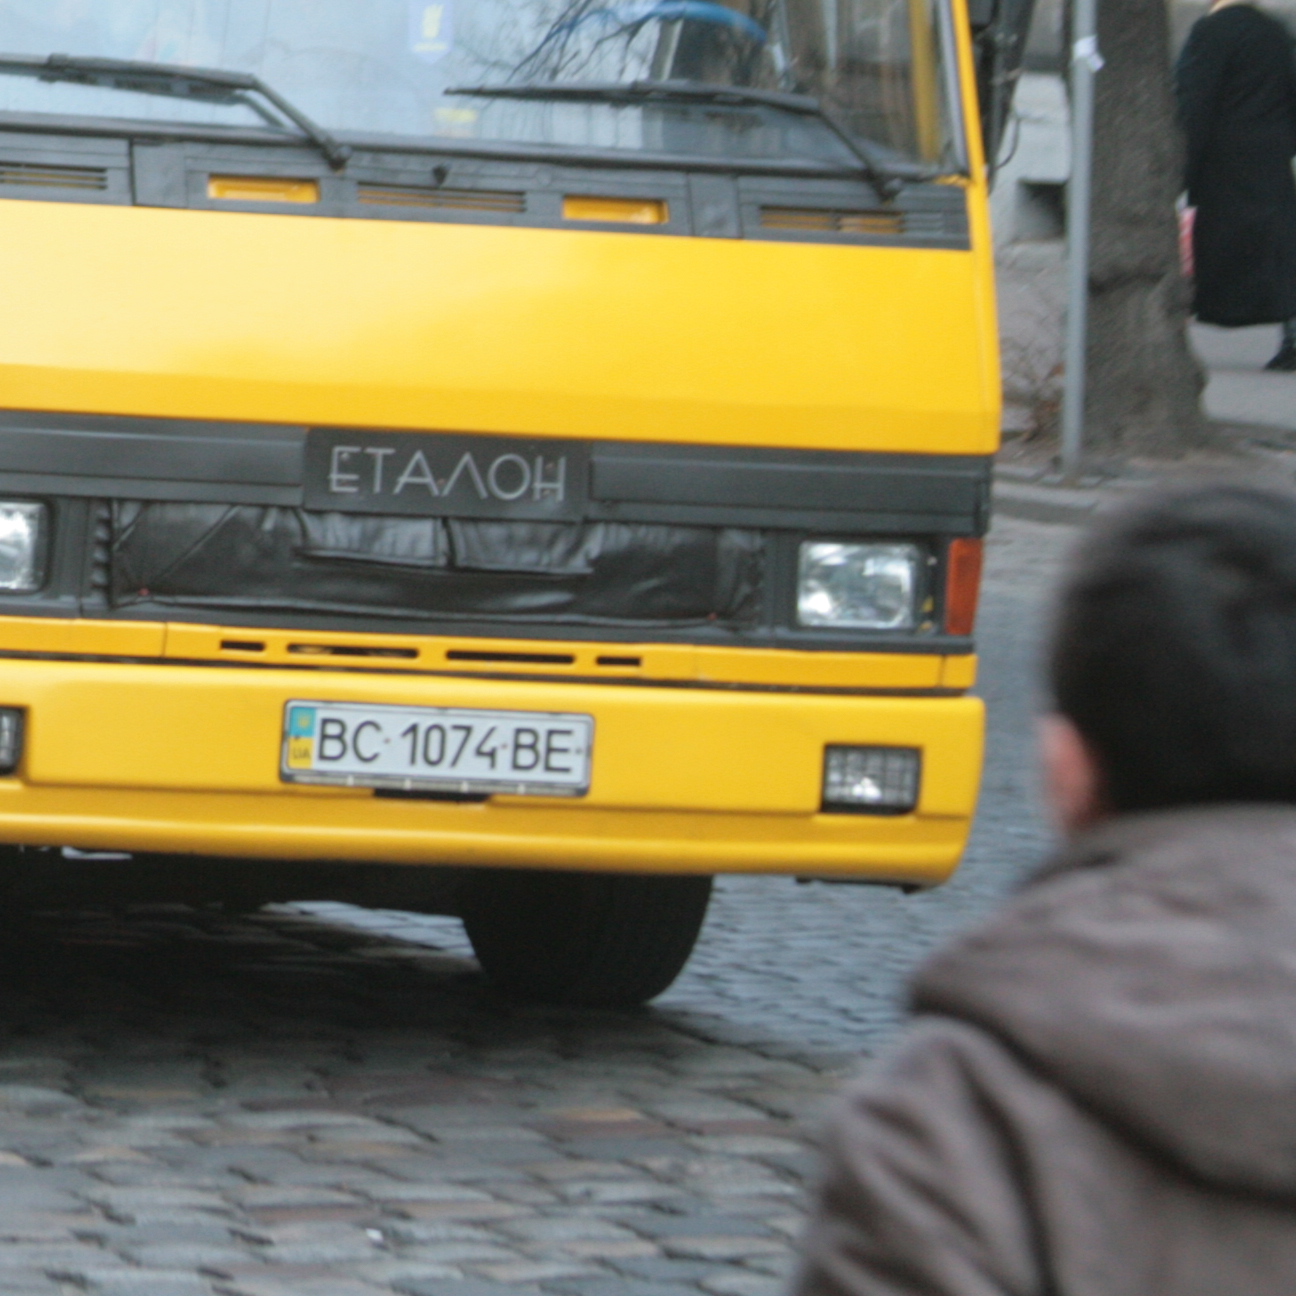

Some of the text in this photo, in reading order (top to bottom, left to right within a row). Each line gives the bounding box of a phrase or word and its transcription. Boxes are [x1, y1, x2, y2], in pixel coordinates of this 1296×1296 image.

[327, 445, 567, 502] ЕТАЛОН
[317, 716, 383, 764] BC
[401, 722, 499, 770] 1074
[511, 727, 575, 774] BE
